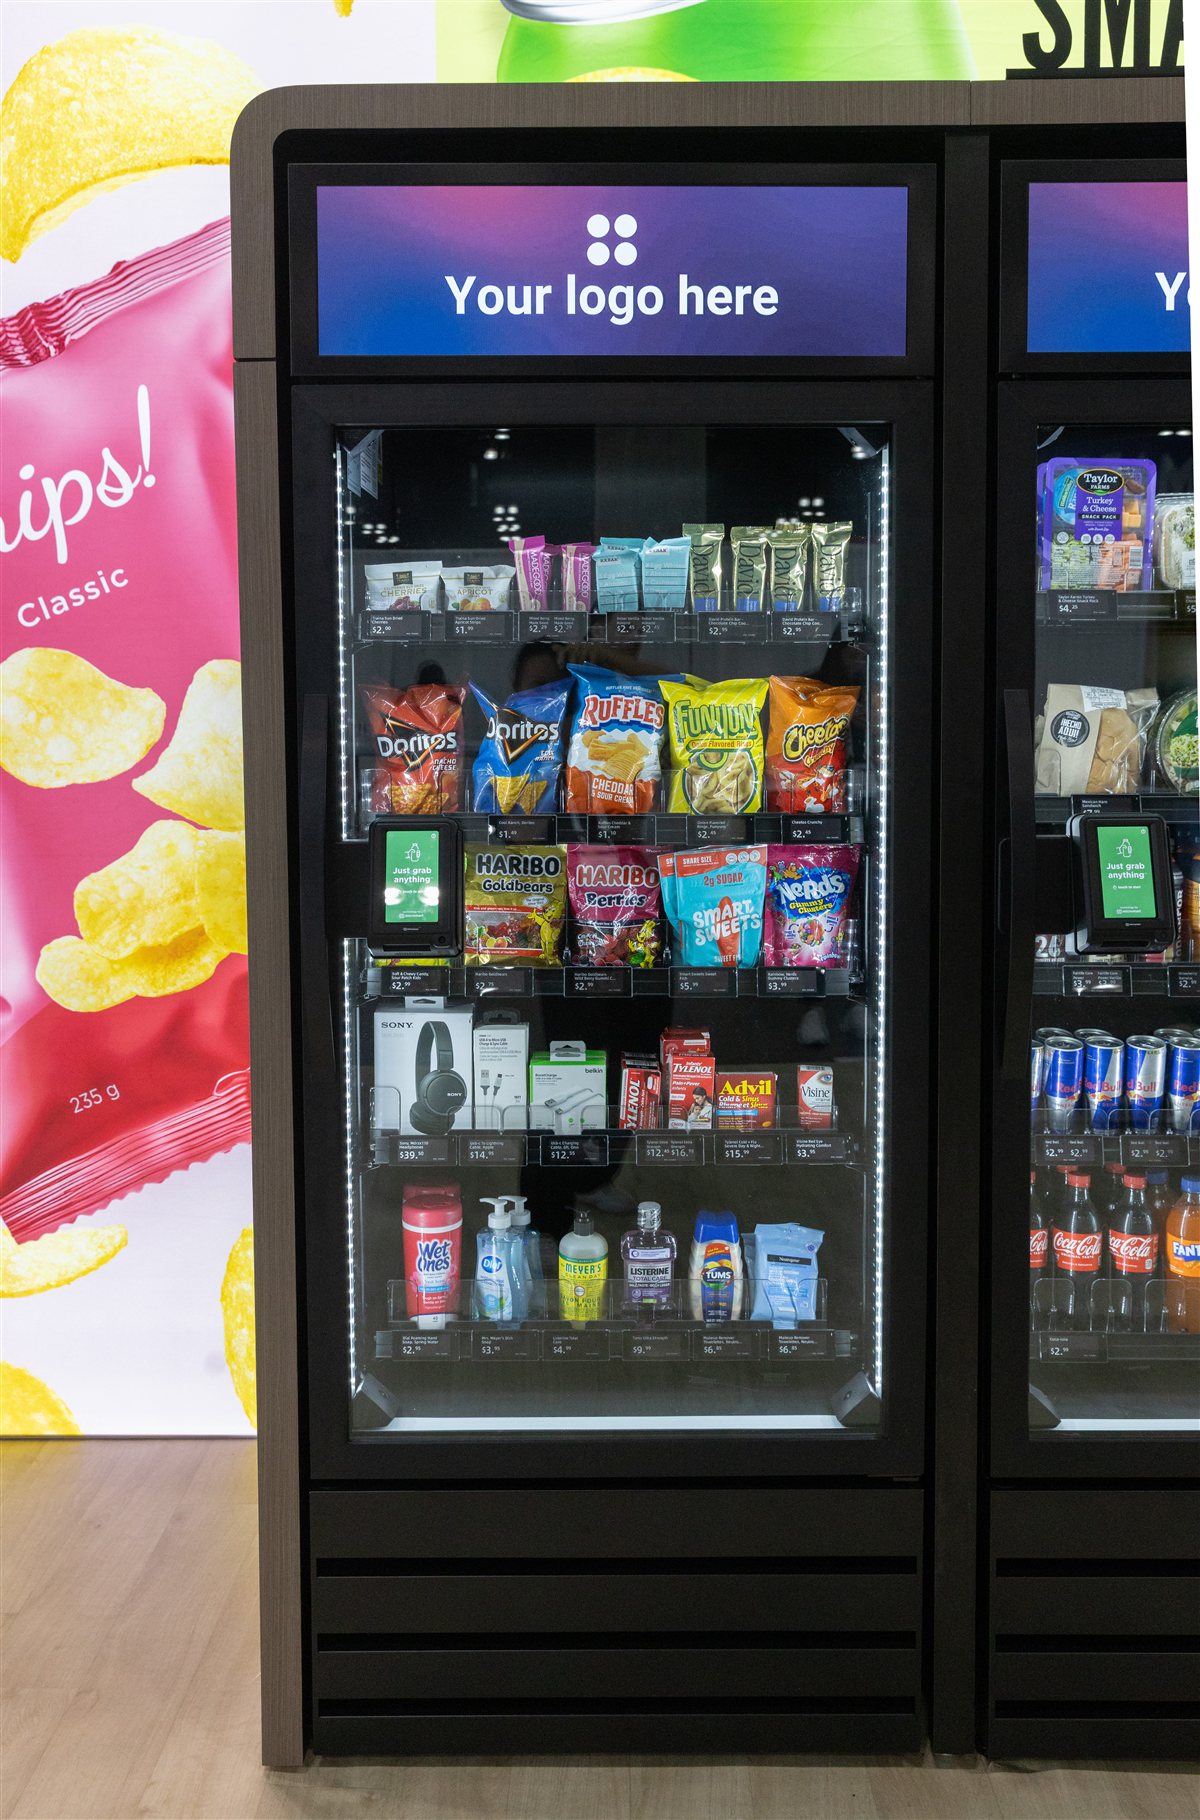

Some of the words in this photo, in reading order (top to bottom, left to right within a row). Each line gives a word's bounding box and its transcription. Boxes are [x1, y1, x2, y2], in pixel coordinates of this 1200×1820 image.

[1155, 272, 1191, 311] Y
[445, 276, 552, 315] Your
[567, 274, 664, 326] logo
[679, 274, 779, 316] here
[0, 384, 156, 565] ips!
[1083, 474, 1118, 484] Taylor
[1086, 496, 1113, 505] Turkey
[1090, 505, 1117, 513] Cheese
[530, 549, 542, 596] MADEGOOD
[692, 543, 715, 595] David
[737, 543, 761, 595] David
[774, 547, 797, 598] David
[820, 543, 842, 593] David
[581, 552, 590, 598] MADEGOOD
[18, 569, 129, 627] Classic
[381, 587, 427, 598] CHERRIES
[457, 588, 494, 596] APRICOT
[372, 626, 392, 634] $2.00
[455, 626, 474, 634] $1.99
[782, 626, 802, 636] $2.95
[583, 694, 664, 729] RUFFLES
[486, 716, 559, 740] Doritos
[784, 715, 850, 760] Cheetos
[377, 731, 457, 757] Doritos
[708, 740, 734, 748] Flavored
[592, 777, 634, 796] CHEDDAR
[597, 792, 612, 801] SOUR
[614, 795, 634, 804] CREAM
[792, 830, 812, 838] $2.45
[476, 853, 561, 877] HARIBO
[683, 856, 700, 865] SHARE
[701, 855, 712, 863] SIZE
[1126, 862, 1145, 870] grab
[412, 866, 432, 876] grab
[576, 864, 659, 889] HARIBO
[1108, 872, 1144, 880] anything
[394, 876, 430, 884] anything
[704, 876, 714, 887] 2g
[716, 872, 743, 885] SUGAR
[482, 879, 554, 894] Goldbears
[585, 891, 648, 908] Berries
[789, 899, 824, 911] Gummy
[693, 900, 755, 928] SMART
[798, 902, 834, 914] Clusters
[695, 913, 761, 946] SWEETS
[392, 982, 411, 990] $2.99
[475, 982, 494, 990] $275
[574, 982, 594, 990] $2.99
[680, 982, 698, 990] $5.99
[768, 982, 787, 990] $3.99
[1073, 980, 1092, 988] $3.99
[381, 1021, 413, 1029] SONY
[673, 1063, 713, 1074] TYLENOL
[718, 1080, 772, 1095] Advil
[802, 1085, 830, 1098] Visine
[1056, 1082, 1076, 1092] Red
[1102, 1080, 1122, 1092] Bull
[1136, 1080, 1156, 1092] Bull
[1174, 1080, 1196, 1092] Red
[69, 1088, 102, 1114] 235
[106, 1084, 121, 1101] g
[400, 1151, 424, 1160] $39.50
[470, 1151, 494, 1160] $14.95
[551, 1151, 576, 1160] $12.55
[725, 1150, 750, 1158] $15.99
[797, 1150, 816, 1158] $3.95
[1054, 1231, 1100, 1256] Coca-Cola
[1109, 1235, 1152, 1257] ca-Cola
[1172, 1241, 1198, 1256] FANT
[418, 1240, 450, 1260] Wet
[418, 1256, 450, 1272] Ones
[630, 1267, 670, 1276] LISTERINE
[402, 1346, 422, 1354] $2.95
[1050, 1347, 1069, 1356] $2.99
